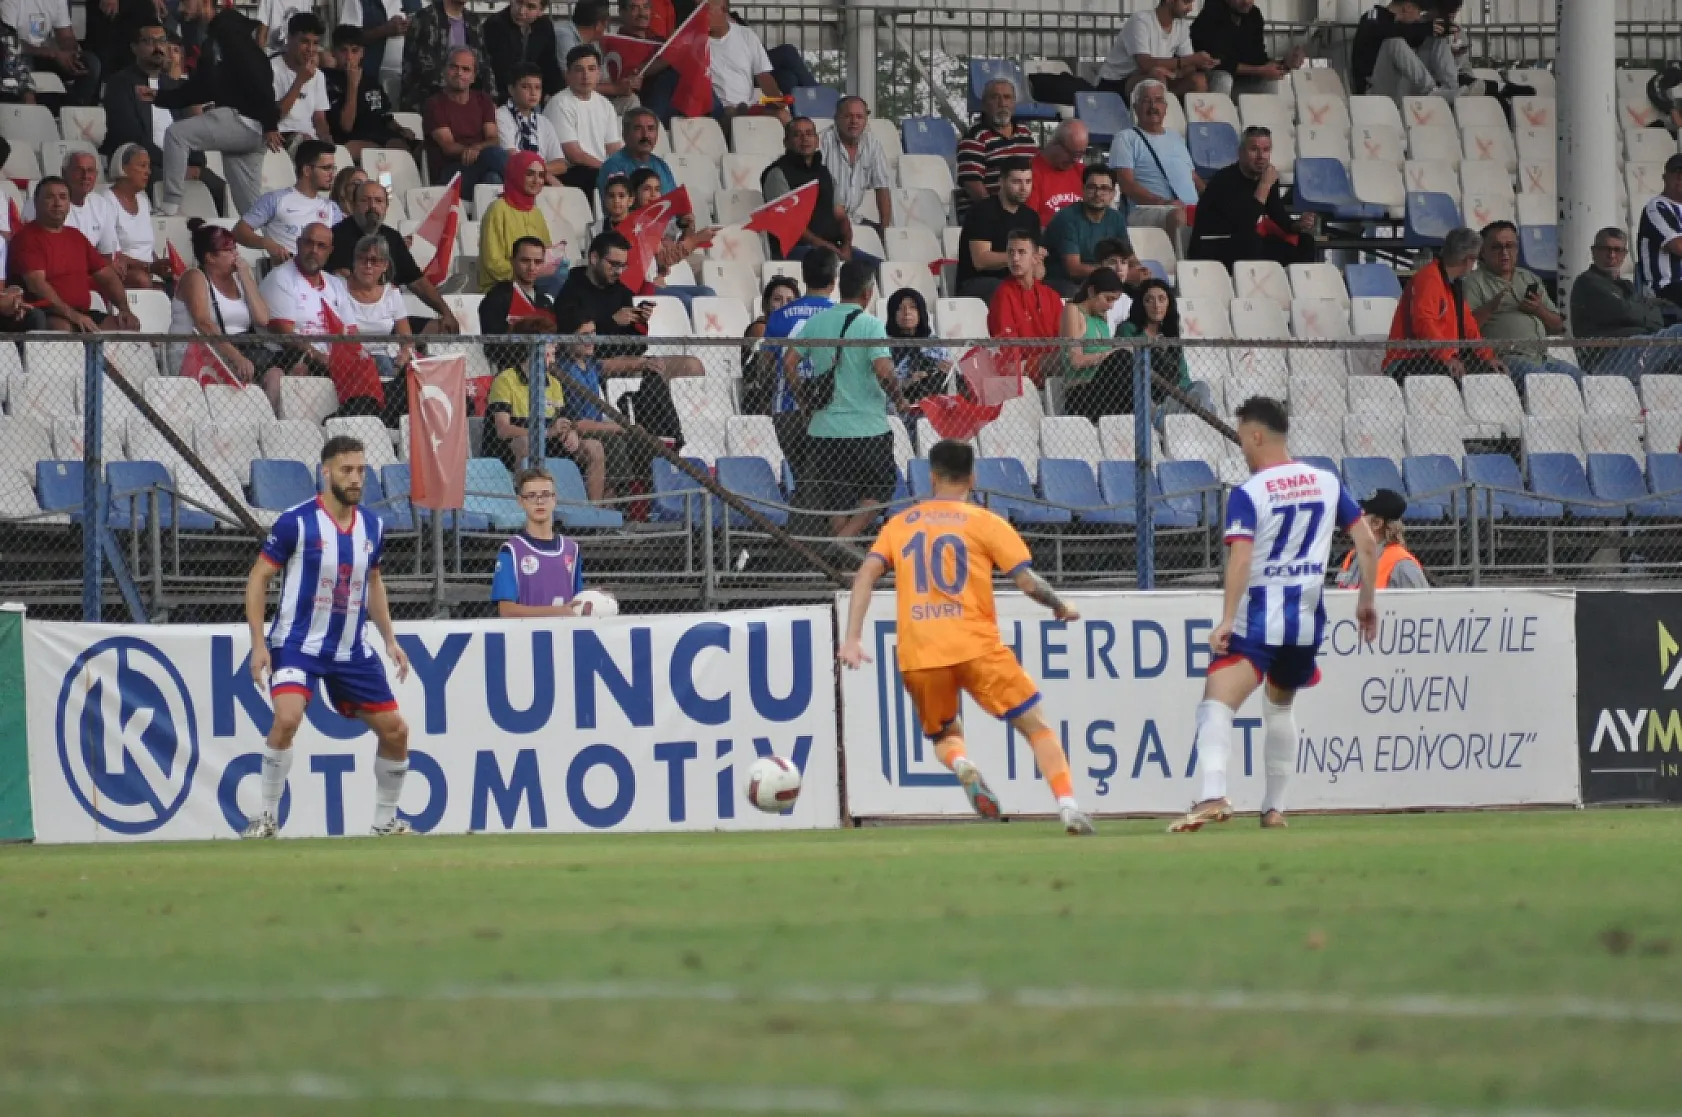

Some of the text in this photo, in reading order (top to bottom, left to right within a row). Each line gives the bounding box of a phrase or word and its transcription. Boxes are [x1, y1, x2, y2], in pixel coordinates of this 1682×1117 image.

[1265, 473, 1317, 493] ESNAF
[1267, 502, 1325, 561] 77
[902, 531, 967, 595] 10
[1003, 619, 1214, 679] HERDE
[1499, 608, 1538, 653] İLE
[1361, 669, 1469, 713] GÜVEN
[1296, 729, 1363, 783] İNŞA
